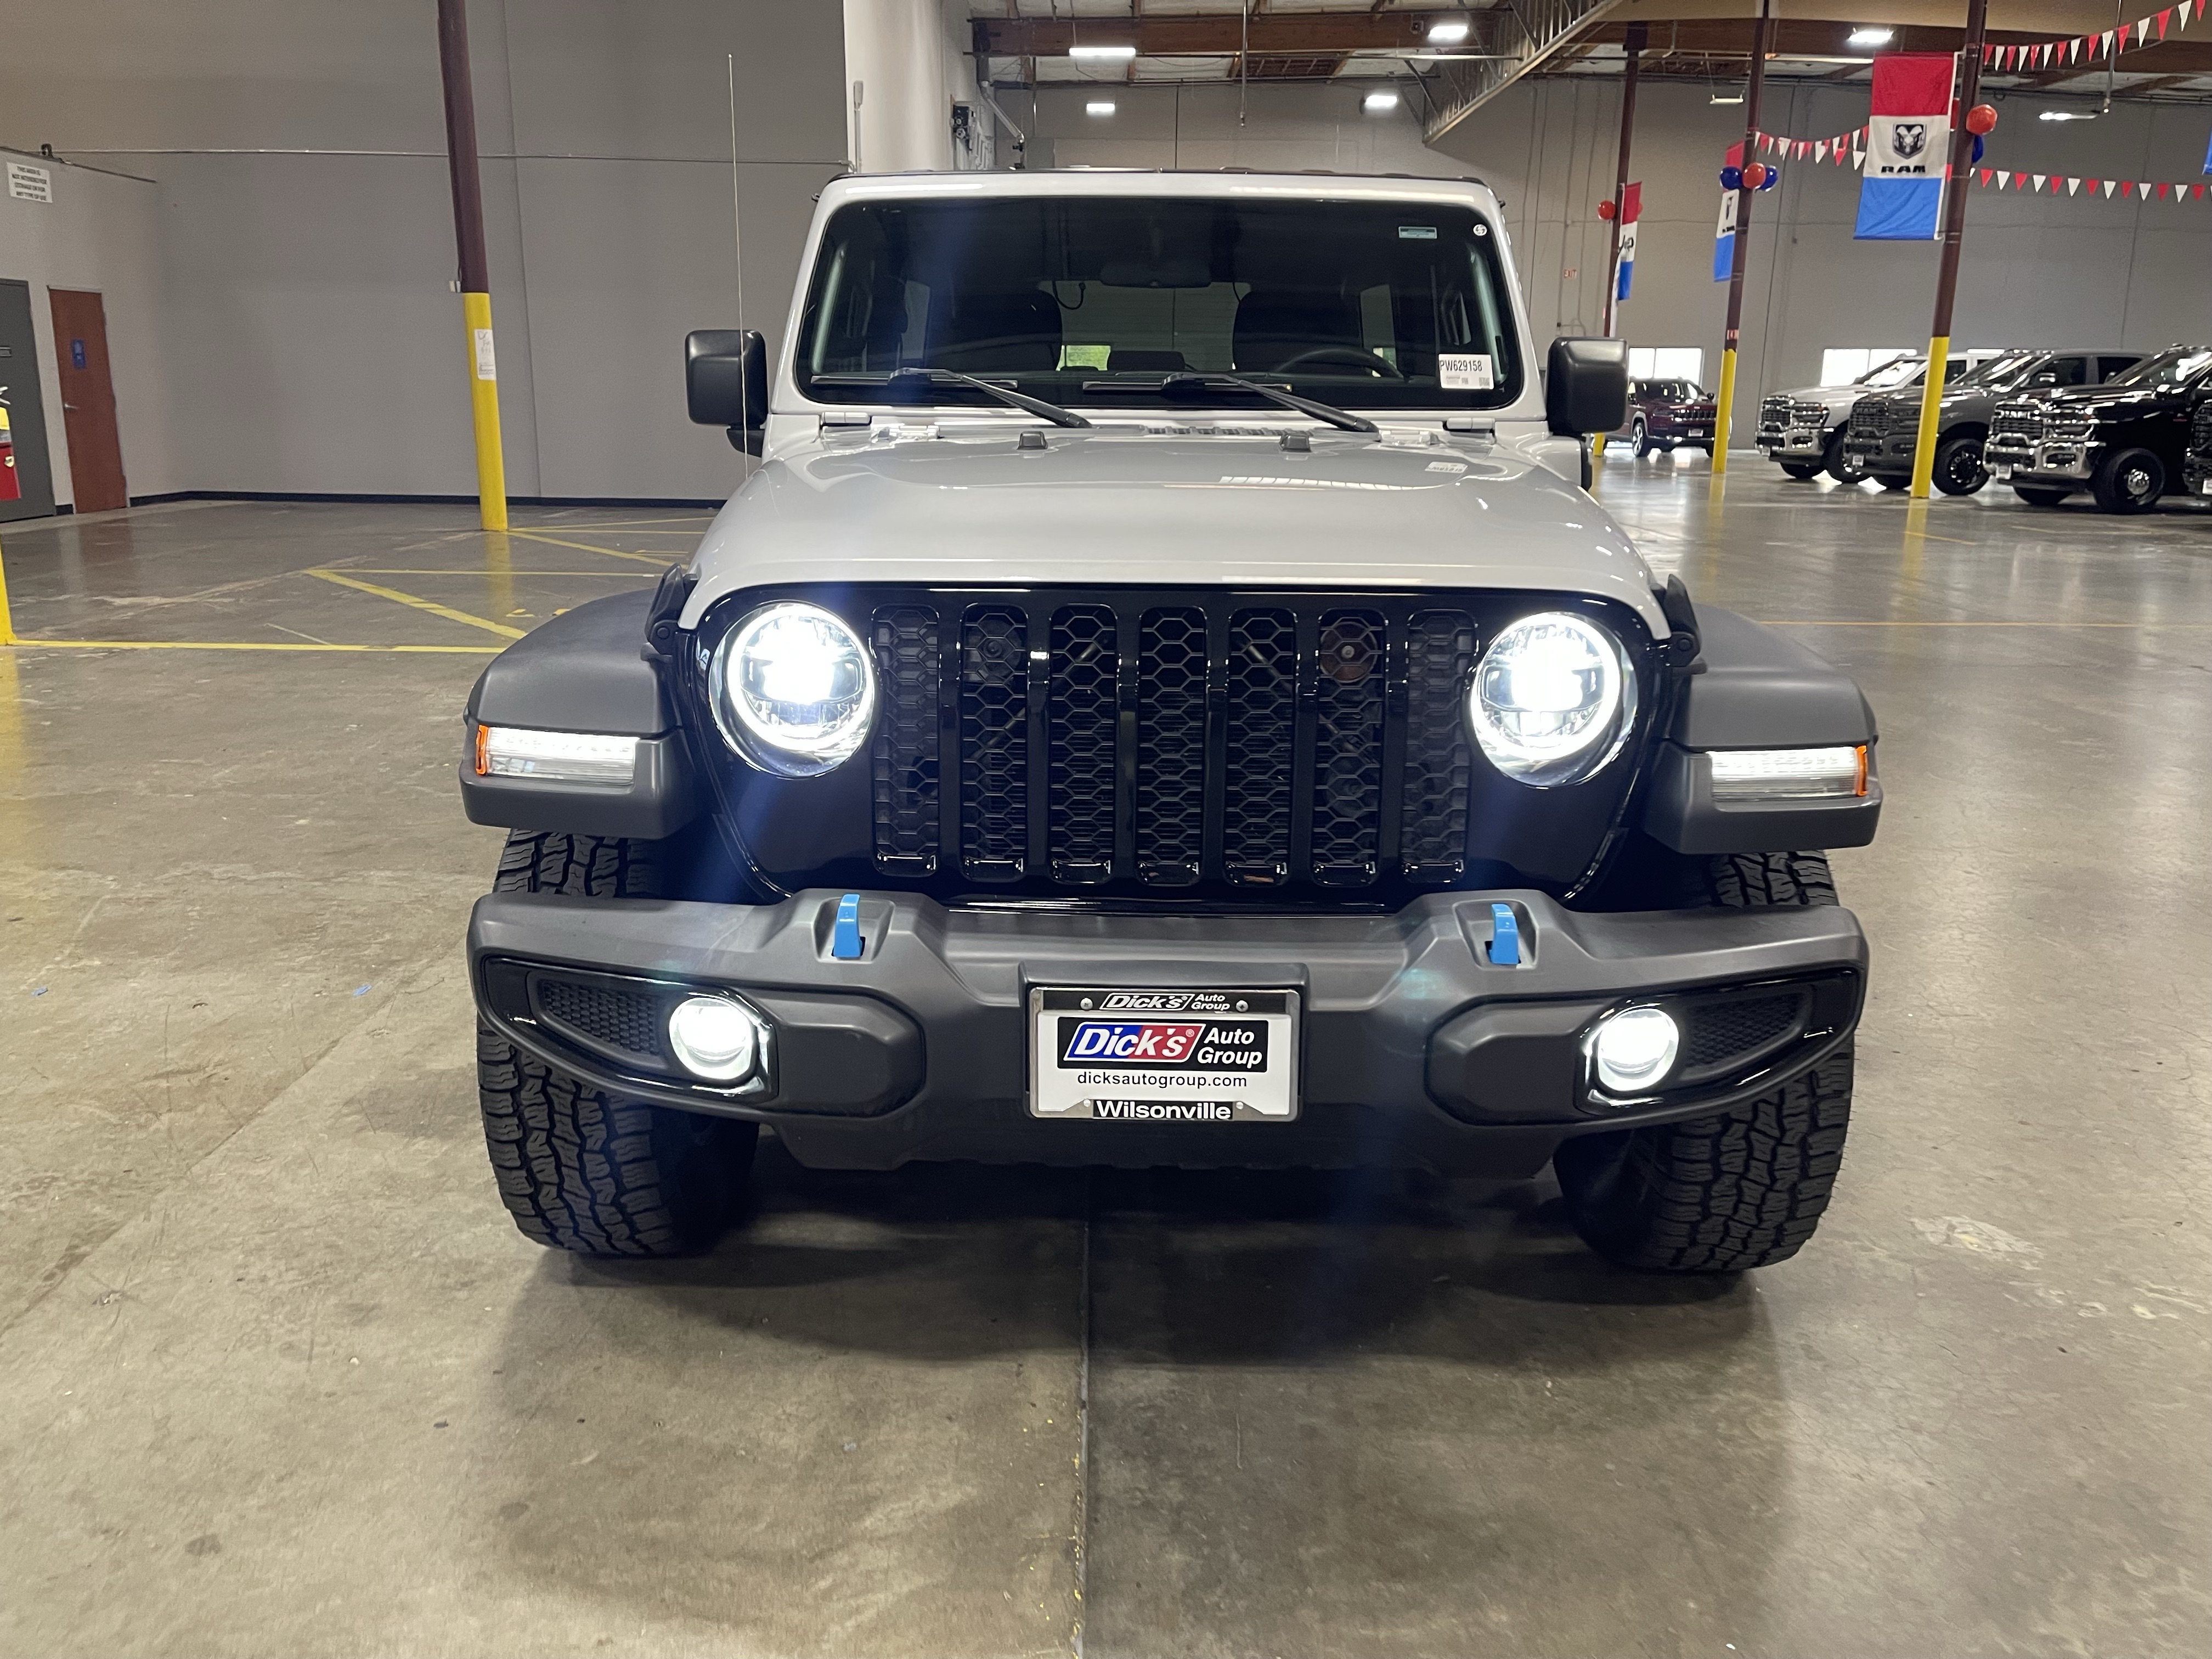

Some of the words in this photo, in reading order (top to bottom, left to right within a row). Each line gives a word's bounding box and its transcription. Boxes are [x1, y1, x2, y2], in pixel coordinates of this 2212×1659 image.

[1881, 165, 1926, 173] RAM
[1439, 360, 1482, 371] PW629158
[1105, 995, 1184, 1009] Dick's
[1194, 994, 1226, 1002] Auto
[1191, 1002, 1230, 1011] Group
[1074, 1027, 1187, 1058] Dick's
[1204, 1028, 1255, 1045] Auto
[1197, 1047, 1262, 1068] Group
[1078, 1071, 1247, 1088] dicksautogroup.com
[1096, 1101, 1231, 1119] Wilsonville
